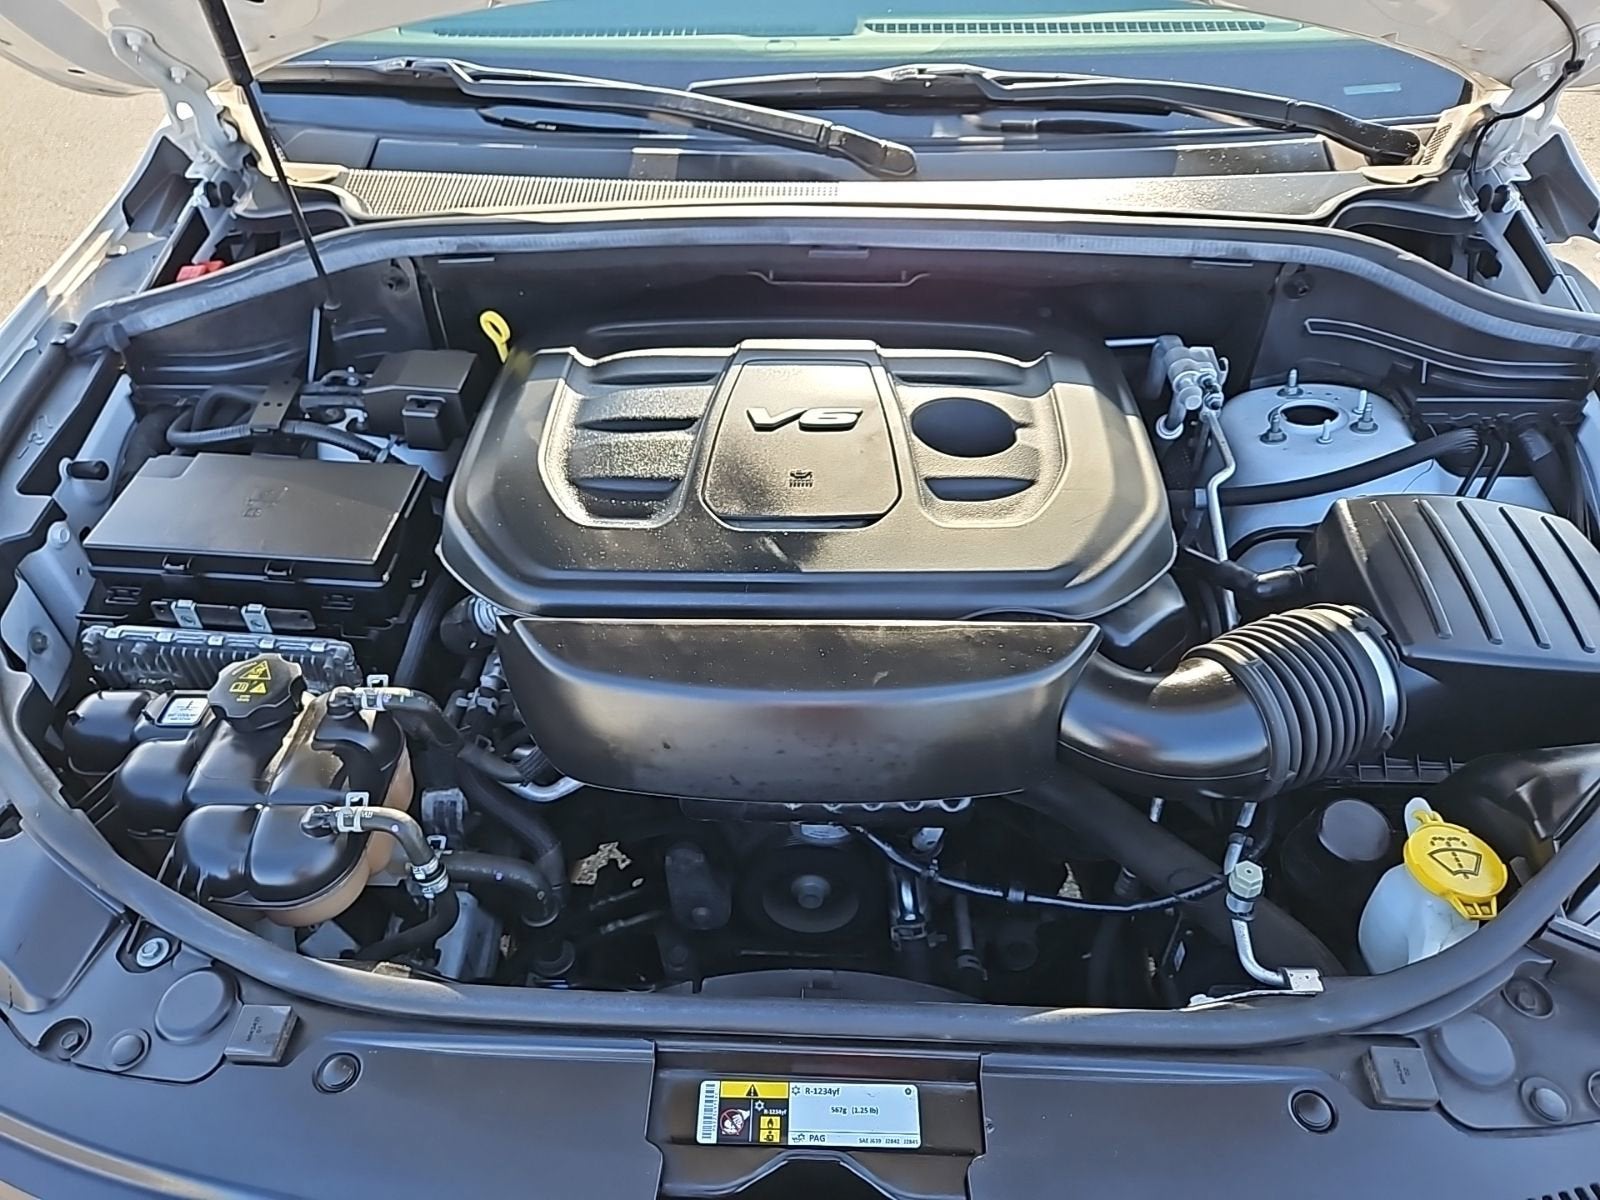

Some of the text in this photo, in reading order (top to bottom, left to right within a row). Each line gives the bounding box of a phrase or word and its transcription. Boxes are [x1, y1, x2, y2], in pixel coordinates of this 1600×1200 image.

[746, 407, 863, 432] V6
[805, 1087, 840, 1097] R-1234yf
[831, 1106, 847, 1115] 567g
[809, 1134, 826, 1142] PAG
